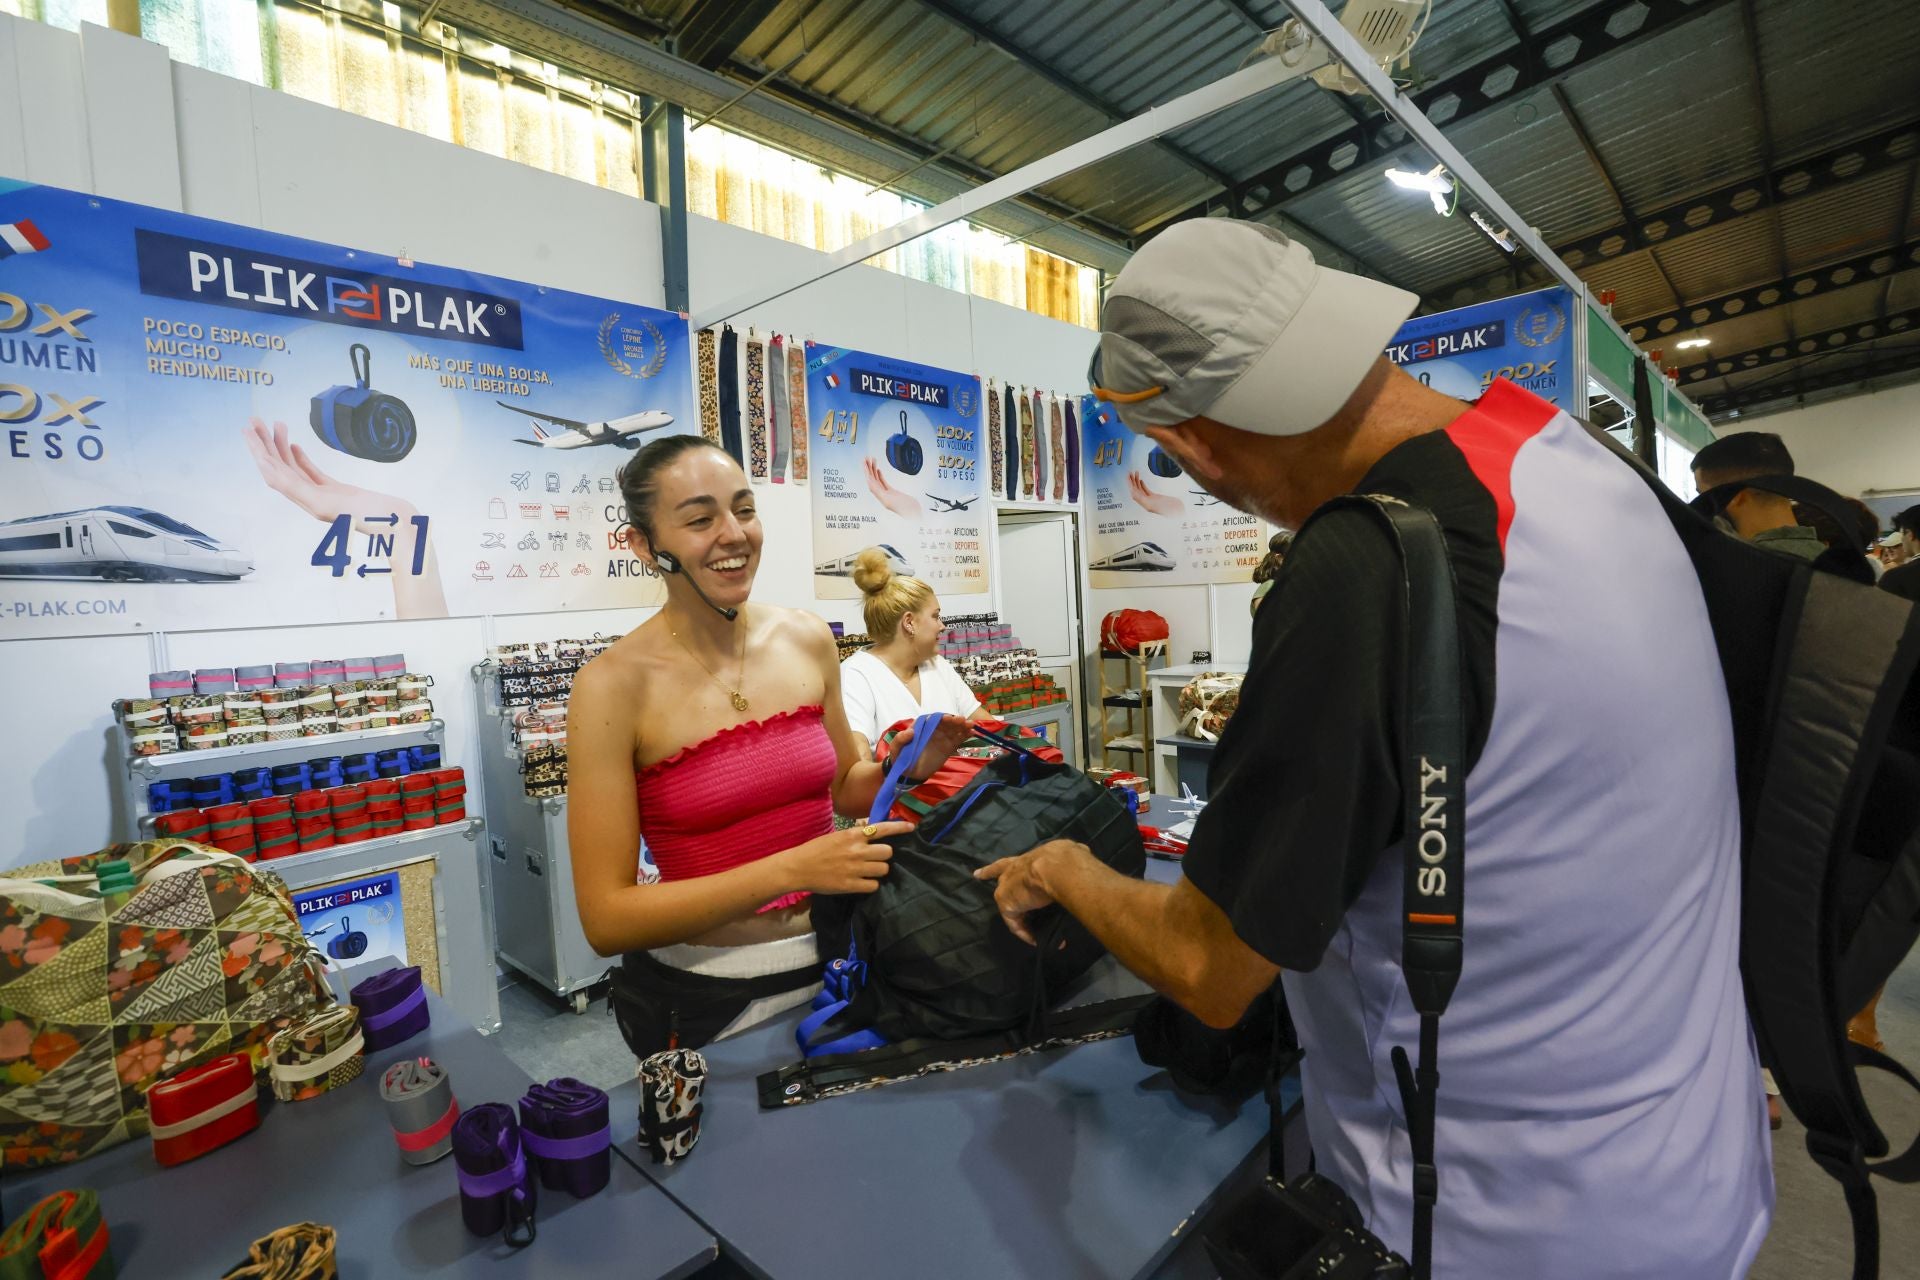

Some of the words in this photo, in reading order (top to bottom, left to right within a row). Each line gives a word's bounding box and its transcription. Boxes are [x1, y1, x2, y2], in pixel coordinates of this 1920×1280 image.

[189, 251, 319, 311] PLIK
[143, 316, 203, 340] POCO
[210, 326, 291, 355] ESPACIO,
[145, 337, 221, 361] MUCHO
[147, 357, 274, 386] RENDIMIENTO
[445, 358, 474, 375] QUE
[477, 363, 505, 379] UNA
[508, 367, 554, 387] BOLSA,
[439, 375, 468, 390] UNA
[472, 377, 531, 397] LIBERTAD
[861, 374, 893, 395] PLIK
[819, 409, 835, 442] 4
[837, 422, 848, 434] IN
[850, 411, 858, 444] 1
[9, 430, 104, 461] ESO
[936, 439, 945, 448] SU
[938, 469, 948, 479] SU
[953, 471, 975, 481] PESO
[824, 491, 858, 499] RENDIMIENTO
[1223, 515, 1257, 526] AFICIONES
[954, 528, 979, 537] AFICIONES
[1225, 529, 1258, 540] DEPORTES
[311, 514, 352, 577] 4
[367, 534, 394, 557] IN
[411, 515, 429, 575] 1
[955, 542, 979, 550] DEPORTES
[1225, 543, 1258, 553] COMPRAS
[955, 556, 980, 564] COMPRAS
[1236, 557, 1259, 566] VIAJES
[964, 570, 981, 578] VIAJES
[1417, 756, 1448, 897] SONY
[301, 896, 334, 914] PLIK
